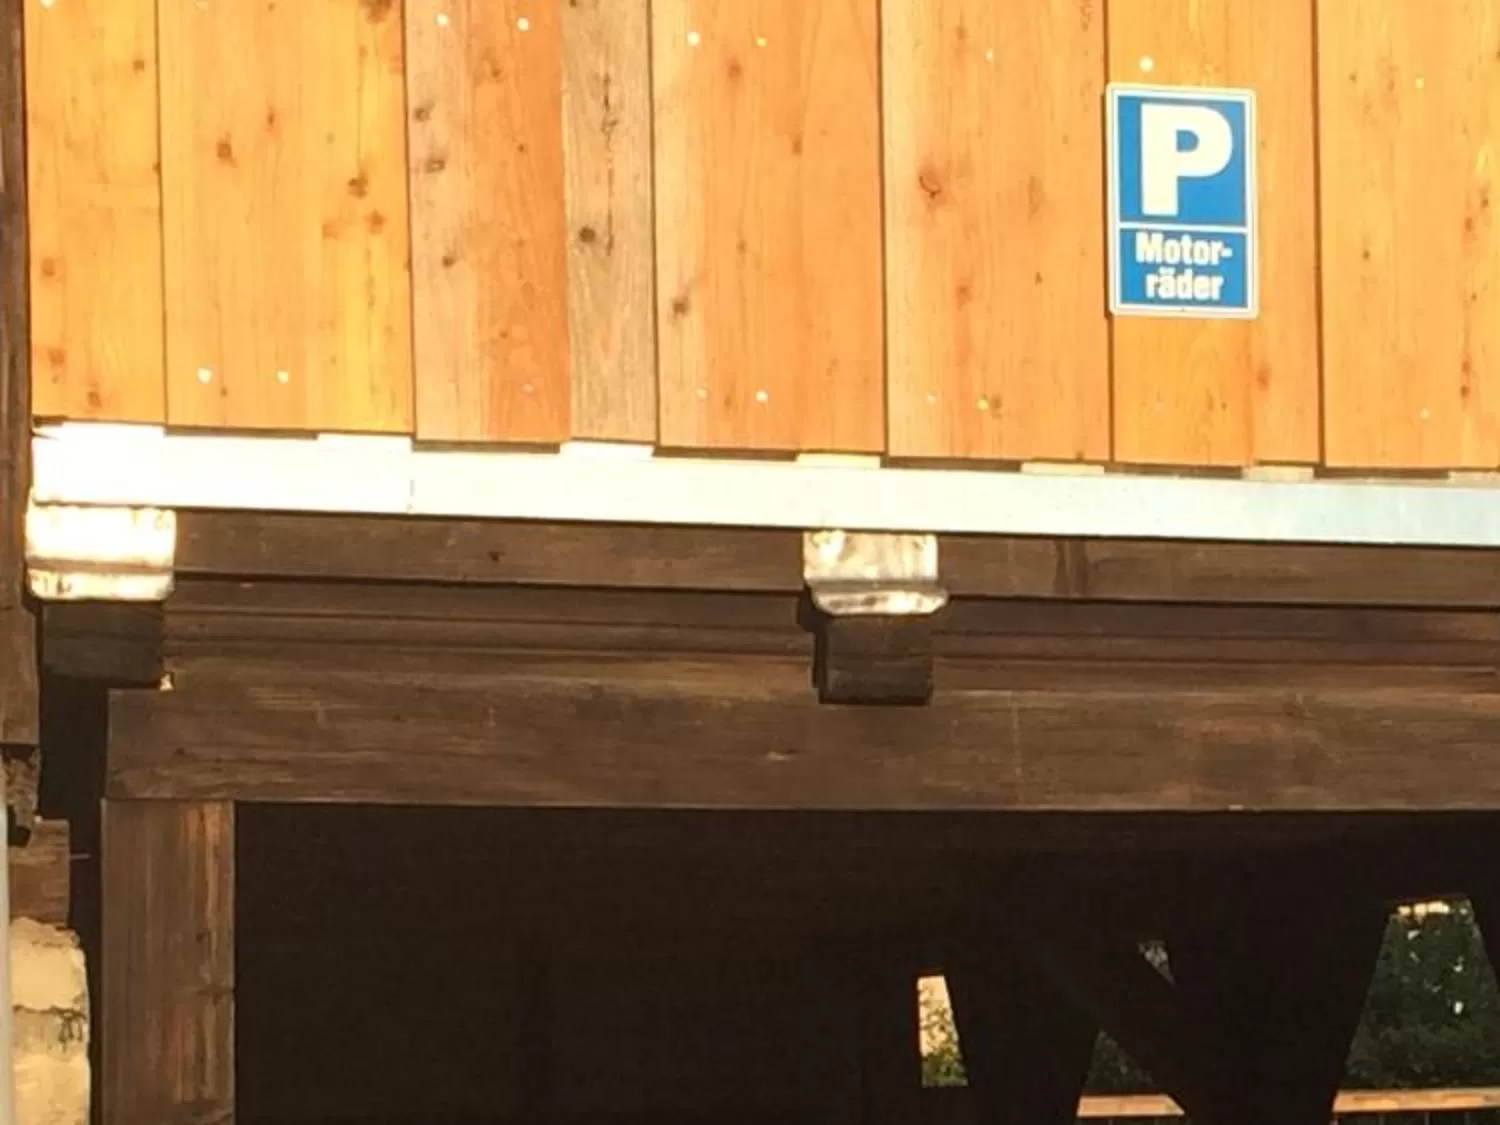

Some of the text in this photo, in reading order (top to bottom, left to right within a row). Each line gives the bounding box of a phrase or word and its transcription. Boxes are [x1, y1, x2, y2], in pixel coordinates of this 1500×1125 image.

[1141, 102, 1233, 216] P
[1135, 231, 1233, 265] Motor-
[1145, 267, 1224, 300] räder
